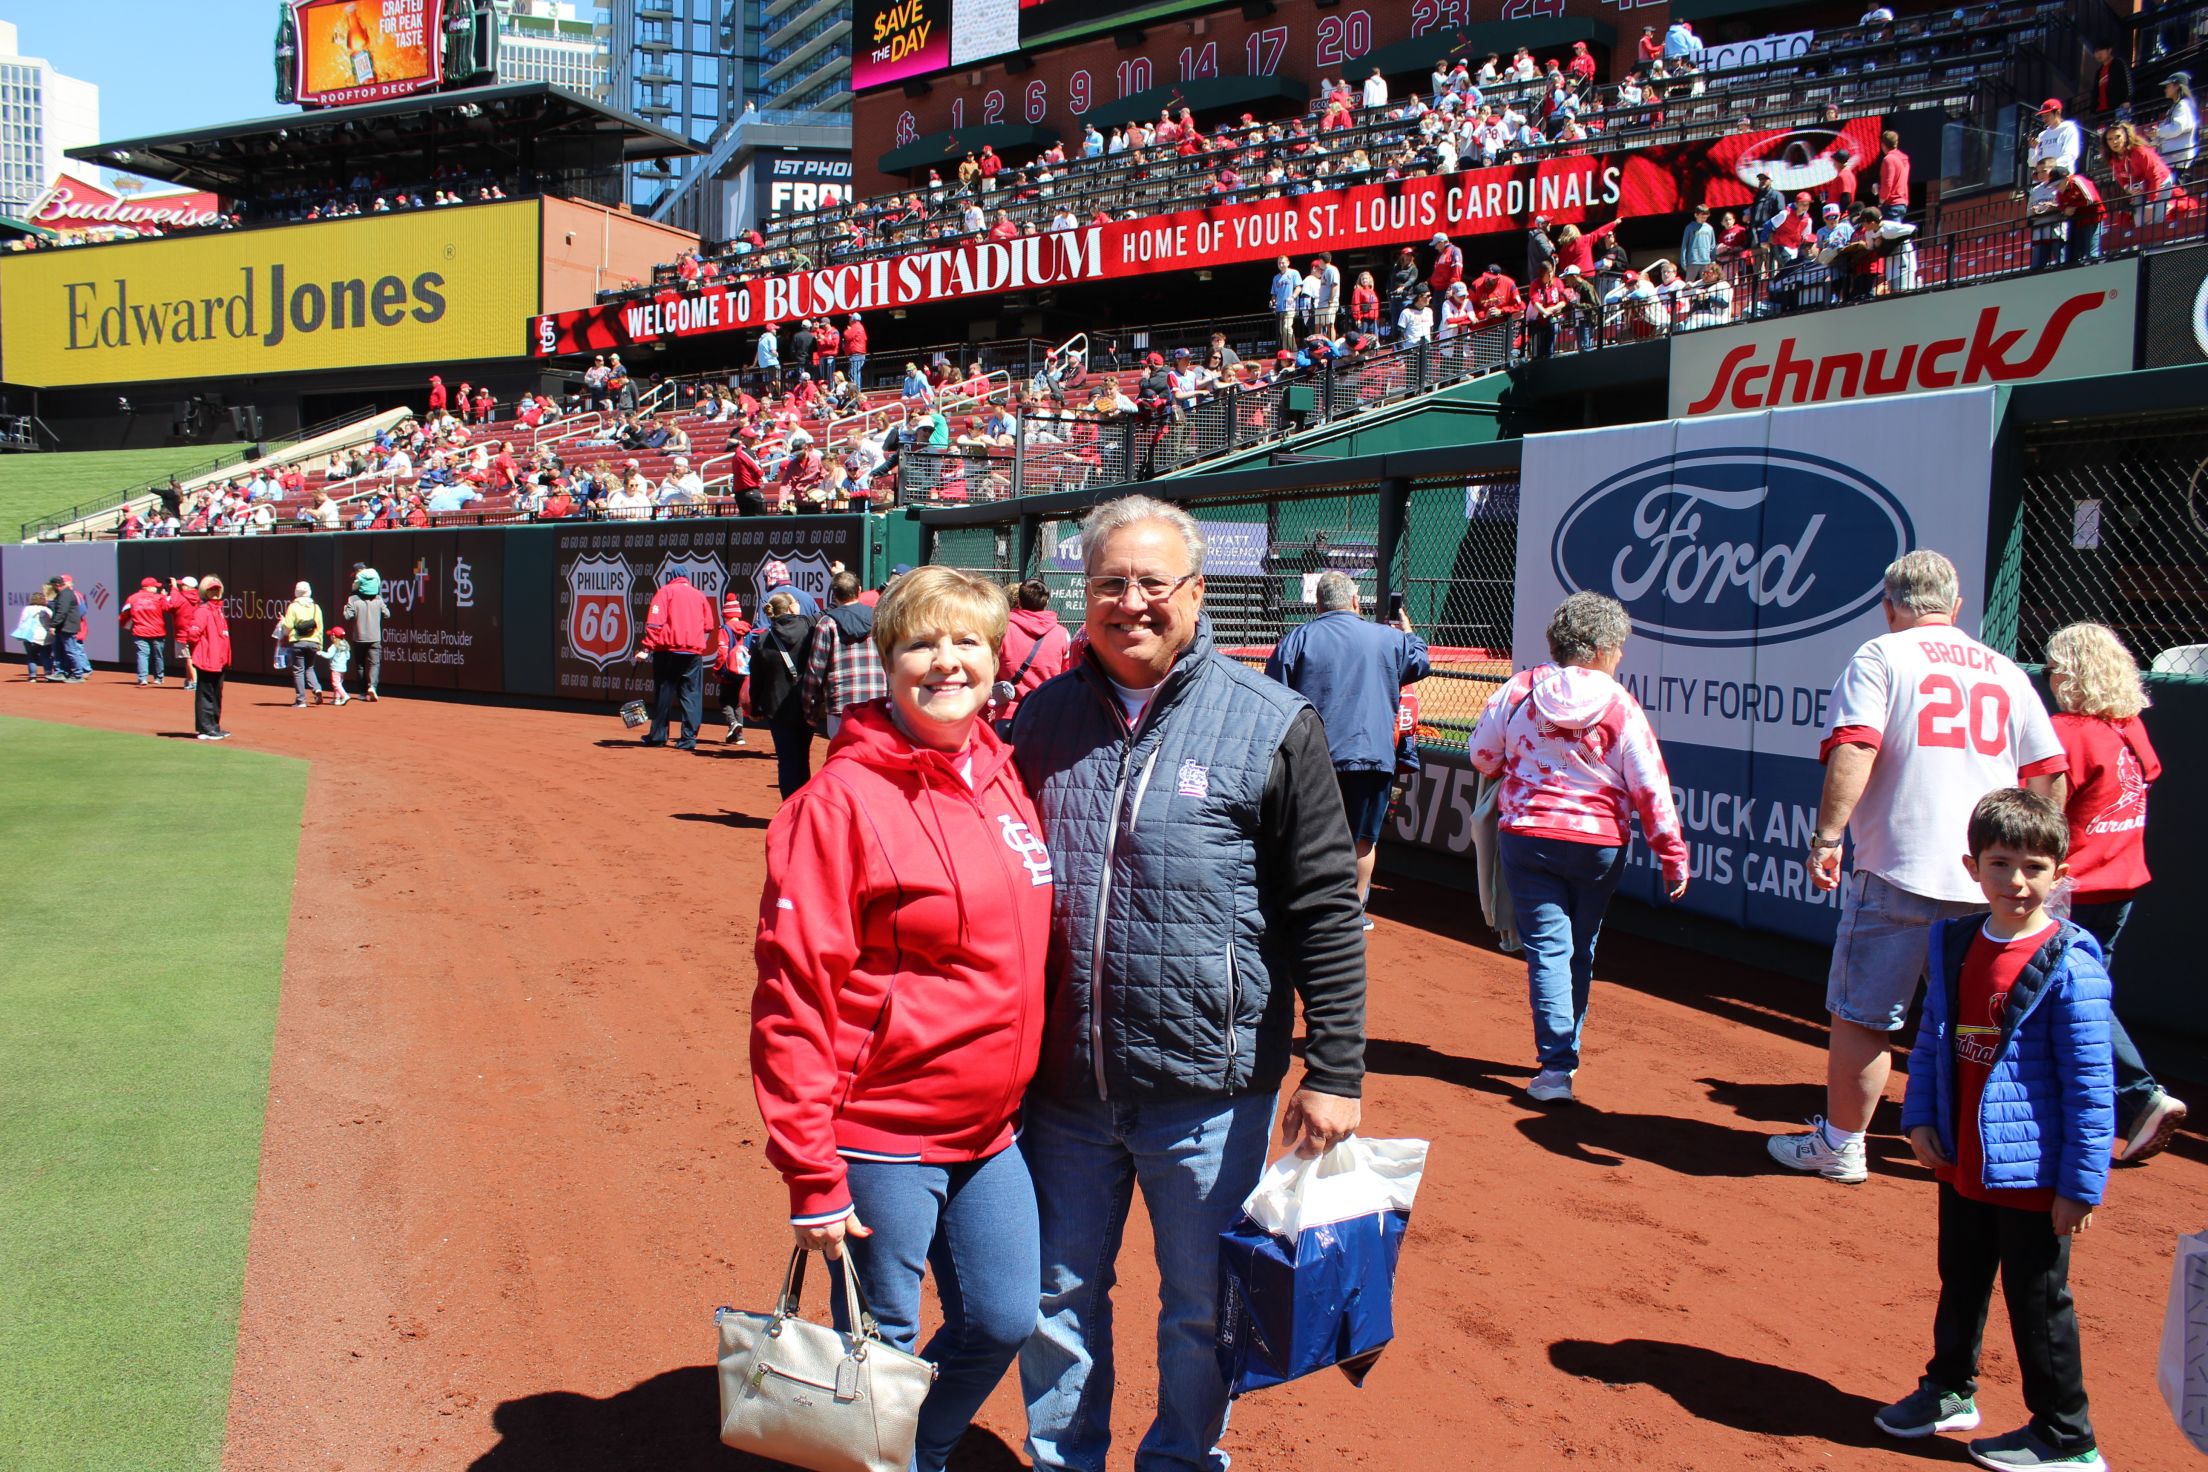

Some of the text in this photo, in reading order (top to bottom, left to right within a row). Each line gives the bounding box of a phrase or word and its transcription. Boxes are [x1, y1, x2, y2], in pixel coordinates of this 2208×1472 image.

[379, 15, 423, 33] FOR PEAK
[382, 0, 423, 17] CRAFTED
[395, 31, 423, 48] TASTE
[872, 20, 932, 64] THE DAY
[952, 97, 963, 129] 1
[984, 89, 1004, 126] 2
[1025, 79, 1046, 124] 6
[1069, 69, 1091, 115] 9
[1117, 56, 1152, 100] 10
[1179, 41, 1218, 82] 14
[1246, 25, 1288, 77] 17
[1317, 9, 1371, 67] 20
[320, 82, 415, 104] ROOFTOP DECK
[773, 159, 804, 175] 1ST
[23, 187, 219, 227] Budweise
[627, 294, 720, 339] WELCOME
[725, 288, 750, 324] TO
[763, 259, 890, 322] BUSCH
[898, 226, 1104, 303] STADIUM
[1122, 225, 1188, 264] HOME
[1196, 220, 1225, 254] OF
[1232, 210, 1299, 249] YOUR
[1307, 204, 1345, 240] ST.
[1355, 190, 1436, 234] LOUIS
[1446, 166, 1621, 223] CARDINALS
[63, 263, 446, 351] Edward Jones
[1207, 534, 1250, 546] HYATT
[1207, 546, 1265, 557] REGENCY
[1611, 483, 1827, 608] Ford
[379, 579, 416, 612] ercy
[577, 571, 624, 591] PHILLIPS
[382, 628, 473, 647] Official Medical Provider
[580, 602, 621, 642] 66
[383, 649, 465, 665] the St. Louis Cardinals
[1918, 641, 1998, 675] BROCK
[1703, 679, 1784, 723] FORD
[1791, 686, 1832, 728] DE
[1917, 673, 2010, 757] 20
[1670, 785, 1818, 850] RUCK AN
